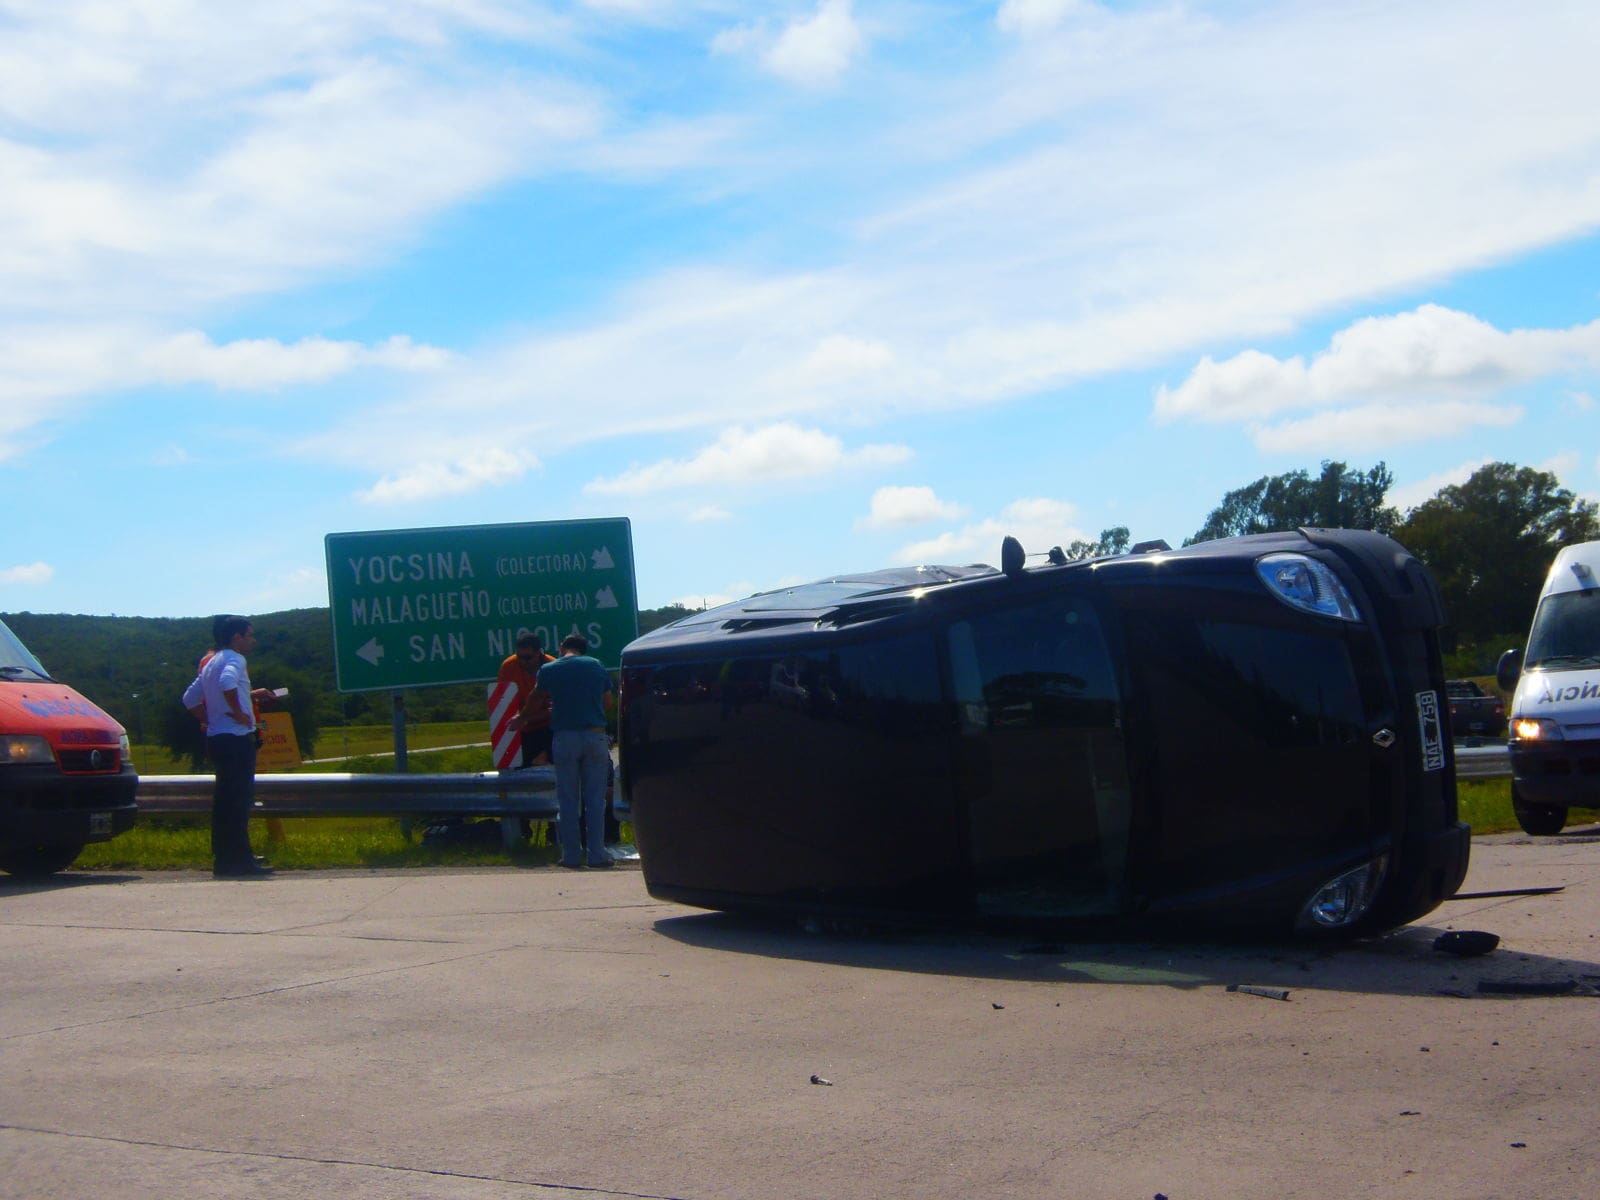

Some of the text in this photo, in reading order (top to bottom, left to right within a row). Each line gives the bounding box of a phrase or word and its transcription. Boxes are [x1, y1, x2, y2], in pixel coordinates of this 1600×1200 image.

[348, 551, 587, 585] YOCSINA (COLECTORA)
[351, 585, 588, 626] MALAGUEÑO (COLECTORA)
[408, 632, 466, 662] SAN
[1425, 736, 1441, 769] NAE
